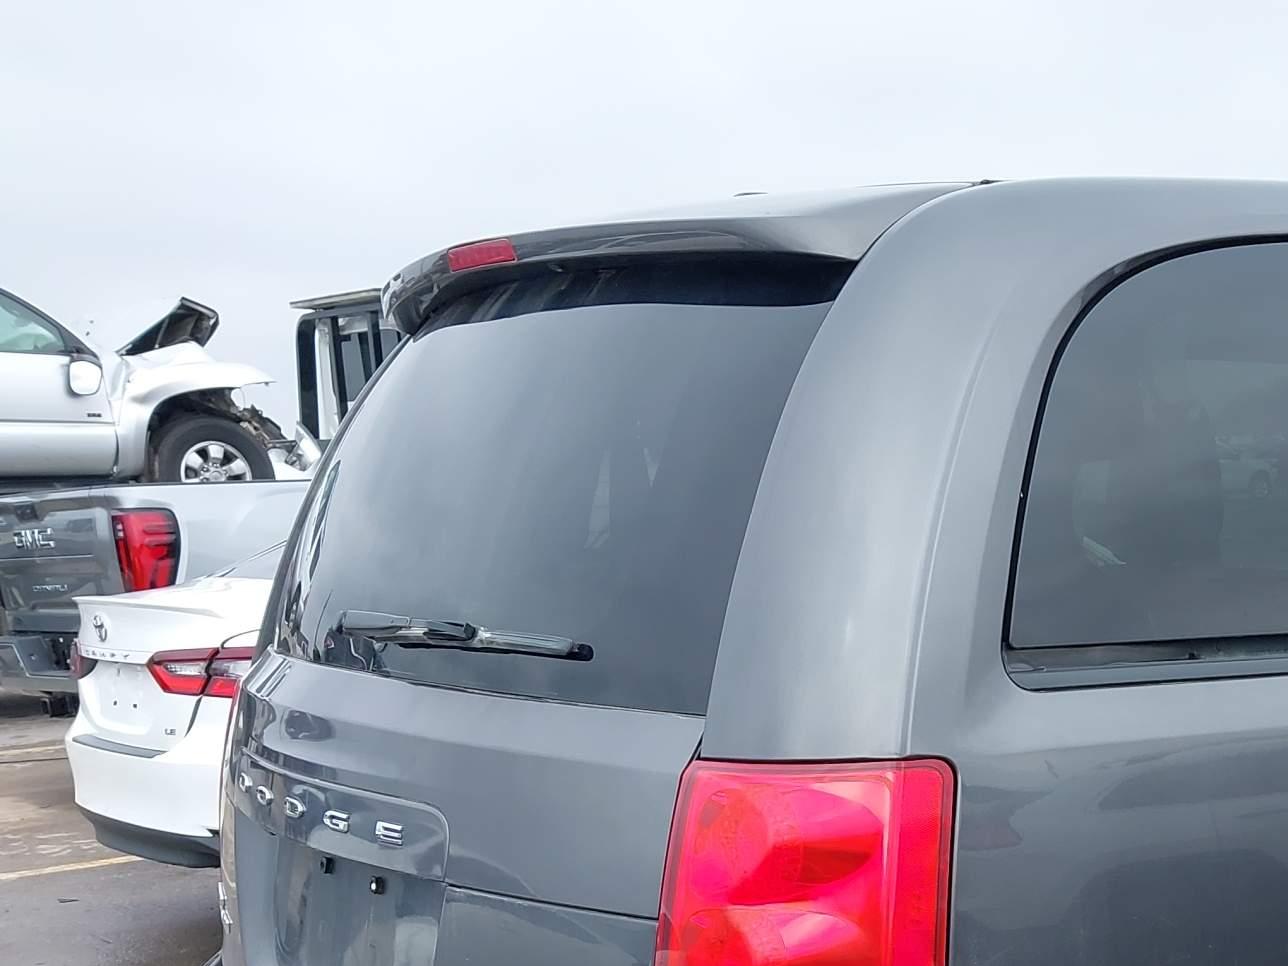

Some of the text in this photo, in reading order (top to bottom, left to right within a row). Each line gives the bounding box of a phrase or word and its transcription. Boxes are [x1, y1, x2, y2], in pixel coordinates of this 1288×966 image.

[14, 528, 55, 550] GMC
[164, 728, 177, 736] LE
[238, 771, 404, 847] DODGE
